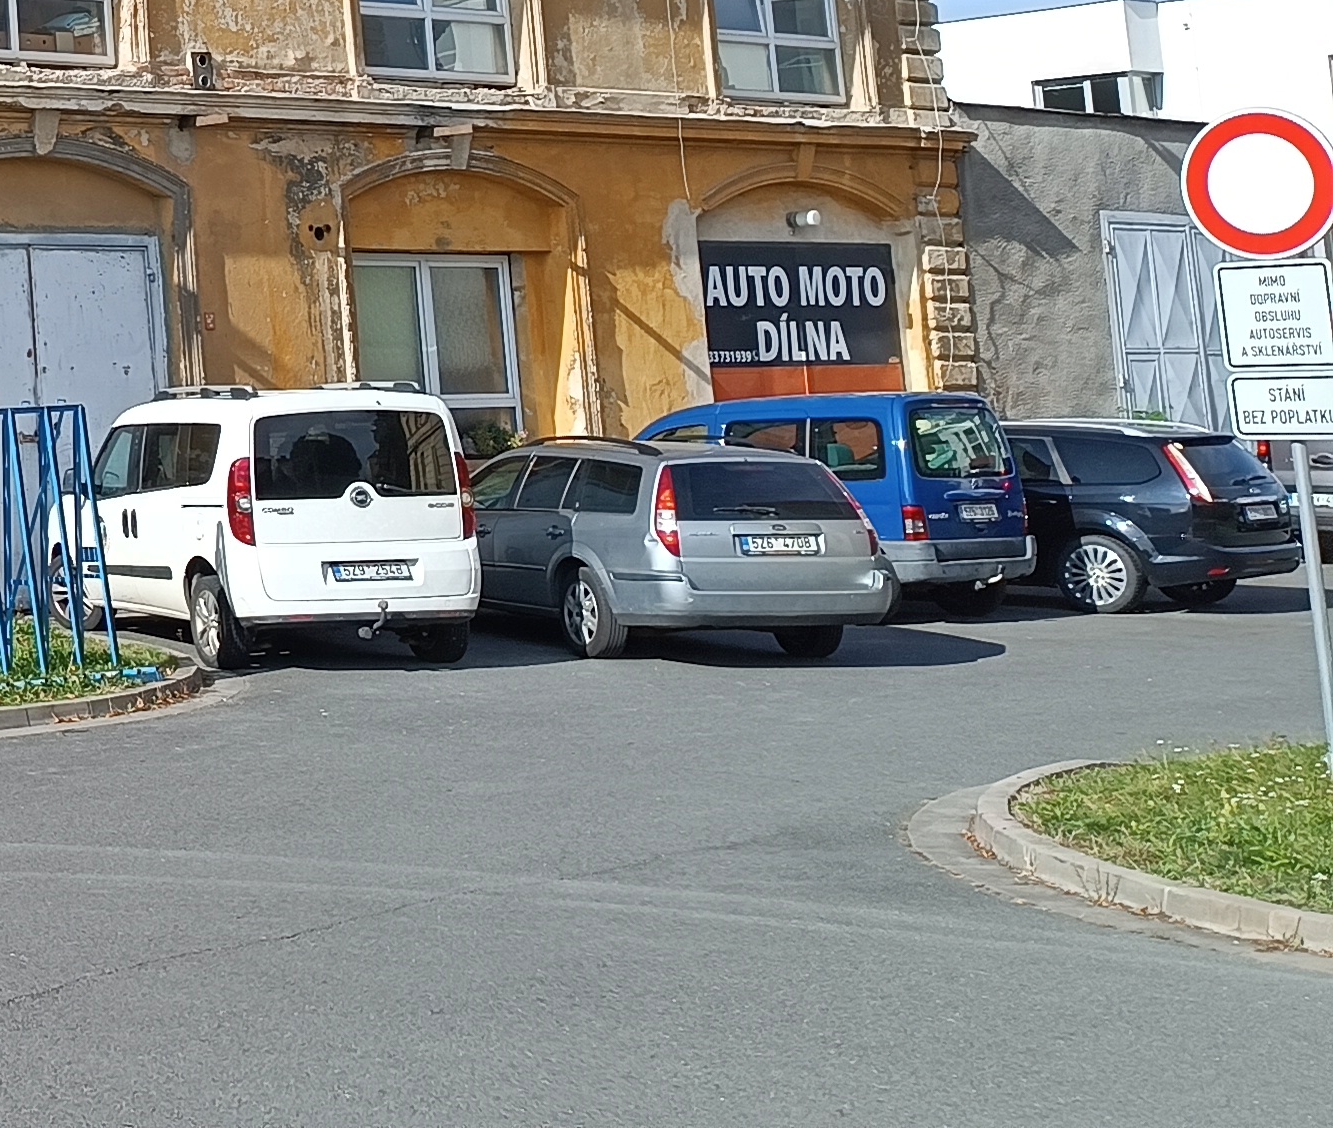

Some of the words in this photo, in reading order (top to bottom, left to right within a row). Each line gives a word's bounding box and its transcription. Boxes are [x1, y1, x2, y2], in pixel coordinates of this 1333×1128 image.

[706, 265, 790, 307] AUTO
[798, 265, 886, 307] MOTO
[1258, 275, 1286, 287] MIMO
[1249, 288, 1300, 305] DOPRAVNÍ
[1254, 309, 1301, 322] OBSLUHU
[756, 312, 851, 362] DÍLNA
[1249, 327, 1312, 340] AUTOSERVIS
[1241, 346, 1249, 357] A
[1250, 341, 1323, 357] SKLENÁŘSTVÍ
[1268, 383, 1306, 403] STÁNÍ
[1242, 410, 1267, 425] BEZ
[751, 537, 774, 550] 5Z6
[782, 537, 811, 549] 4708
[343, 565, 367, 577] 5Z9
